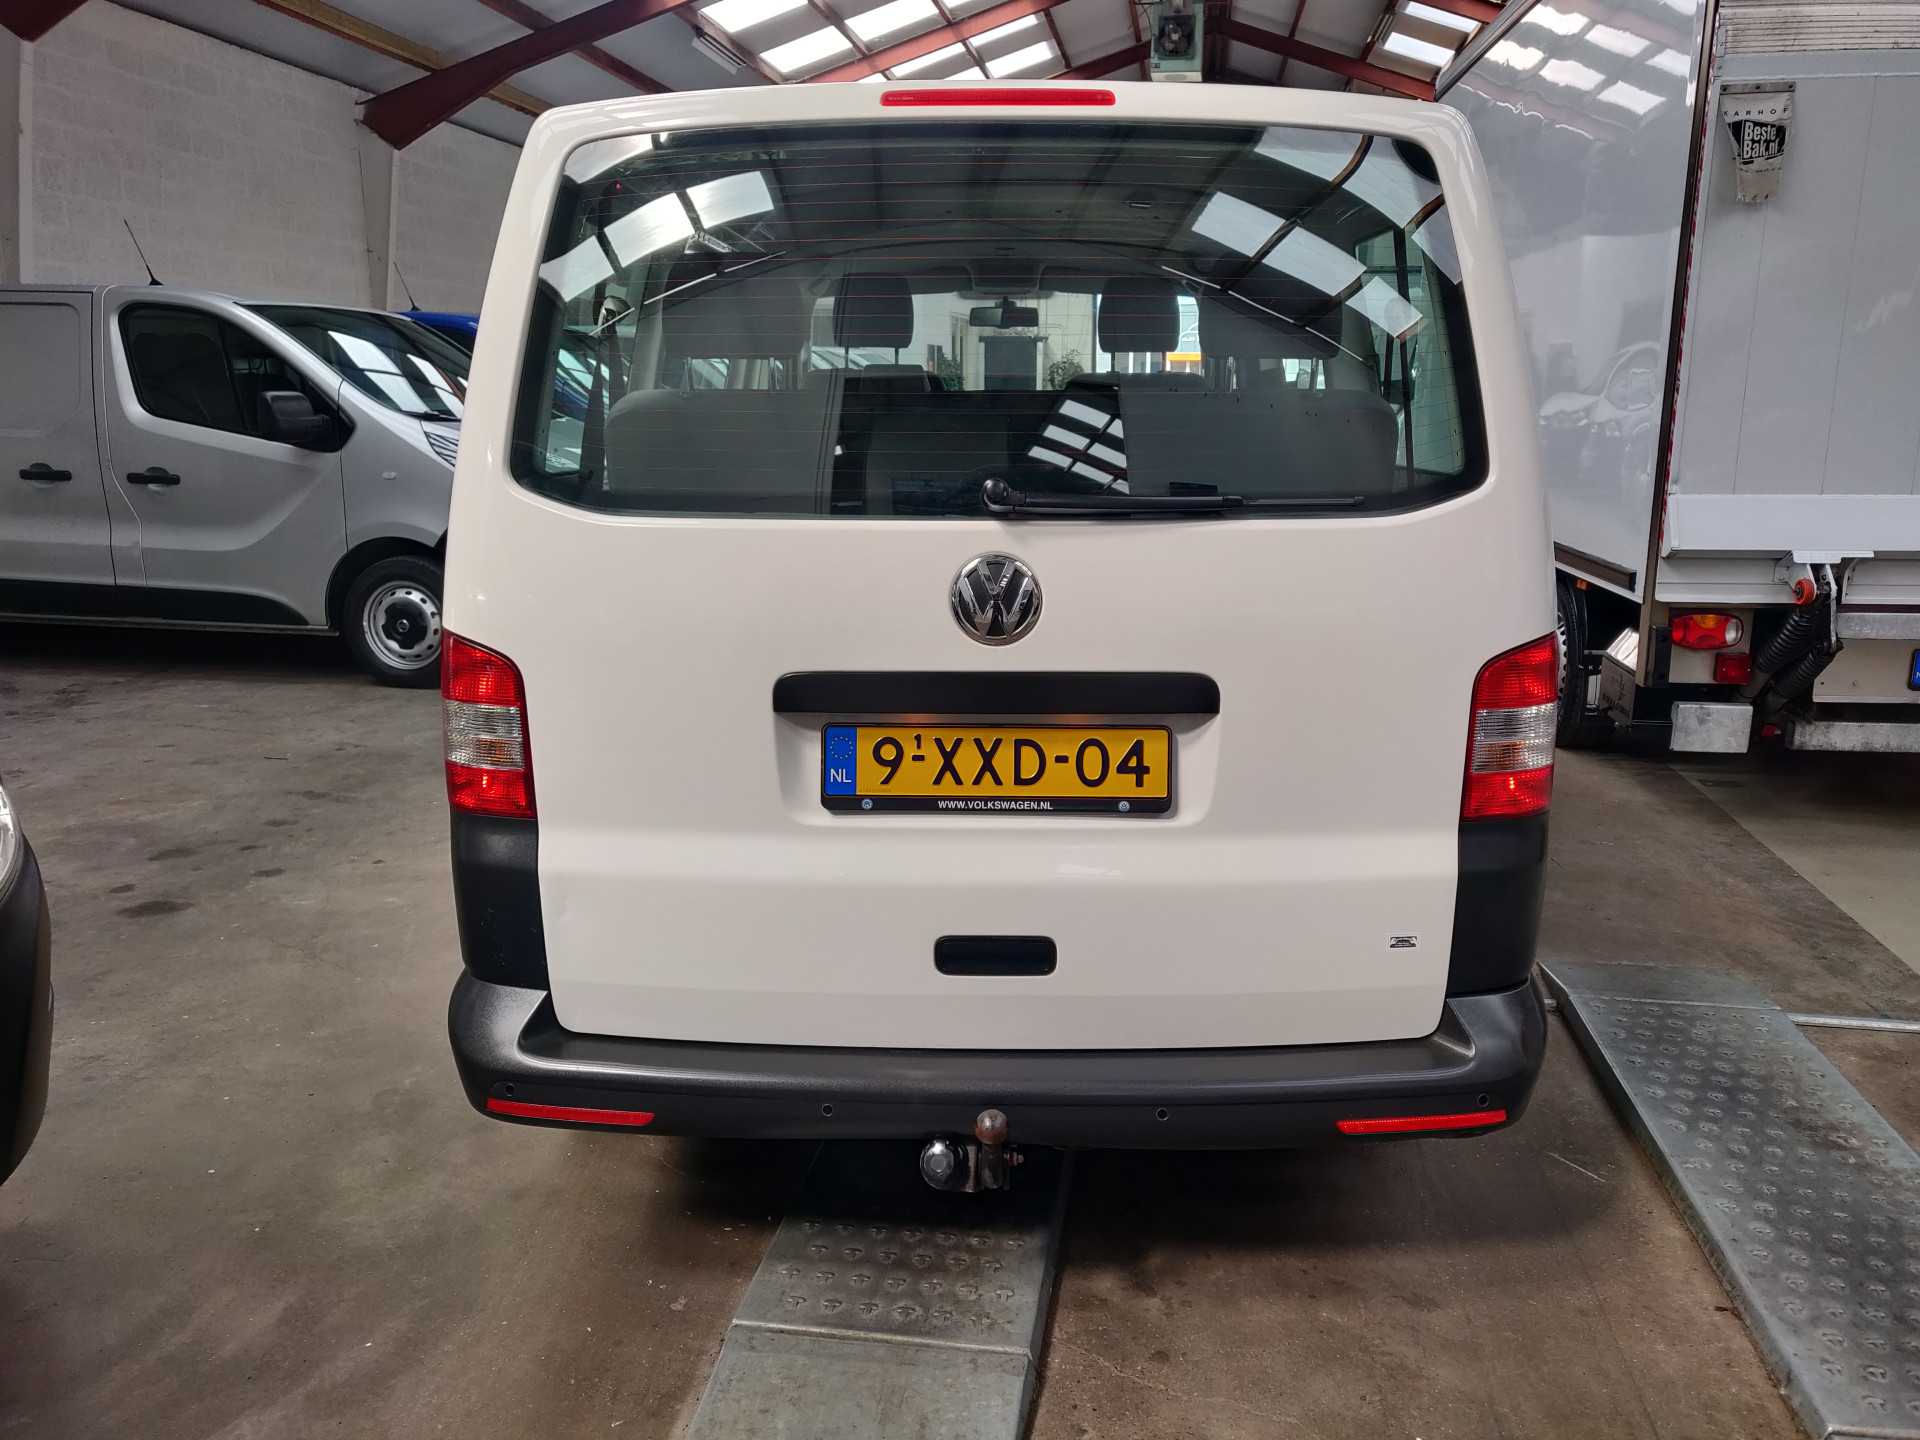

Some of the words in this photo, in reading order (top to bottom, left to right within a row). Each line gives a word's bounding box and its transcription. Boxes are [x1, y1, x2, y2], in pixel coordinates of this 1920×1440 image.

[1744, 121, 1777, 141] Beste
[1743, 138, 1779, 159] Bak.nl
[829, 768, 852, 784] NL
[937, 800, 1054, 810] WWW.VOLKSWAGEN.NL
